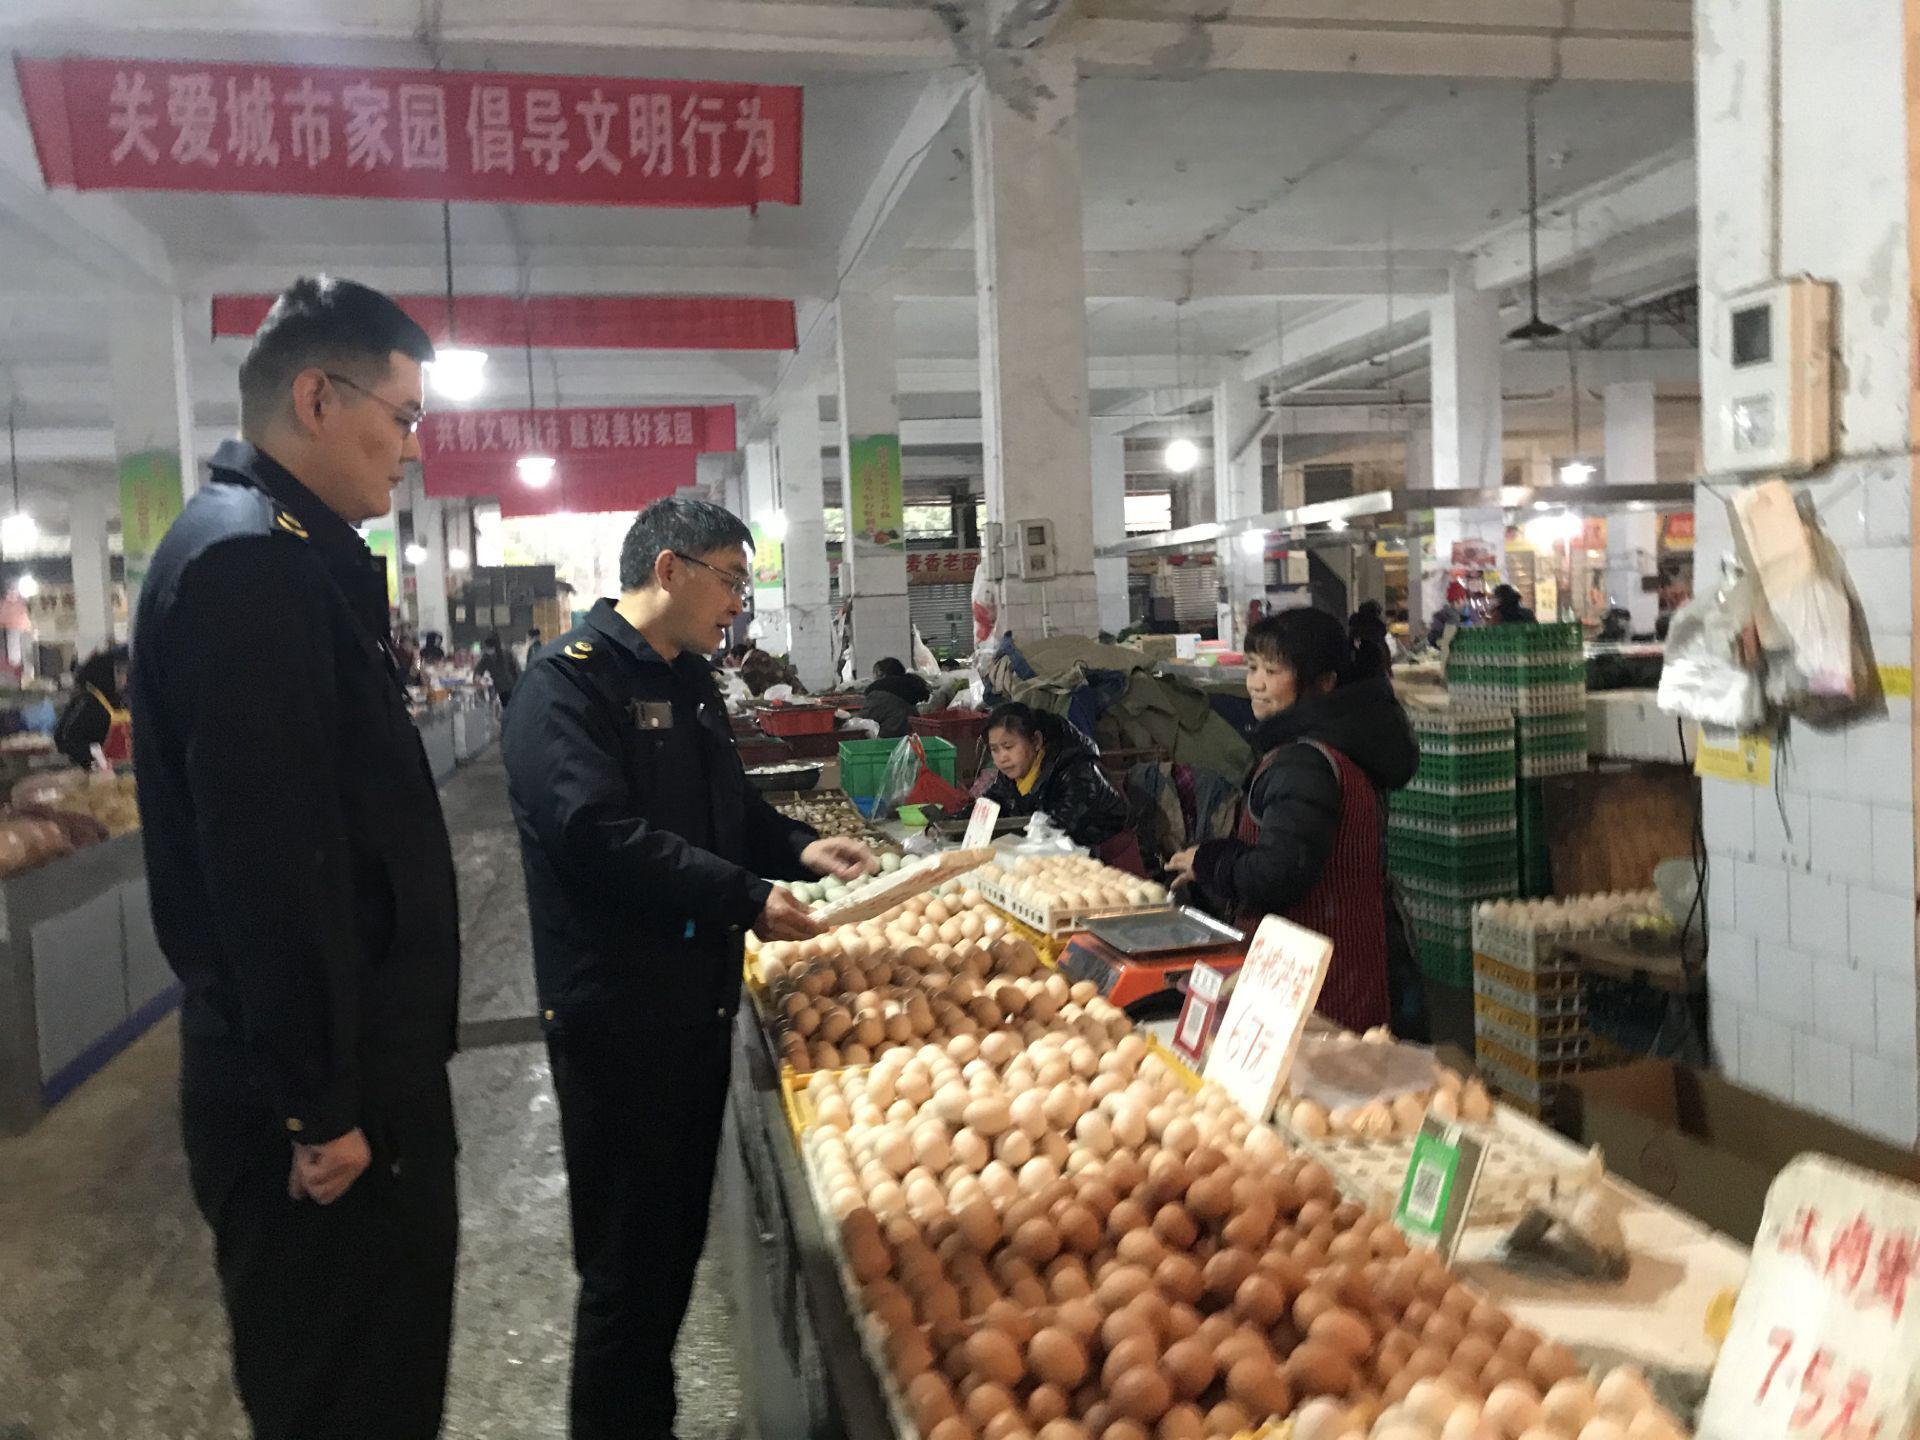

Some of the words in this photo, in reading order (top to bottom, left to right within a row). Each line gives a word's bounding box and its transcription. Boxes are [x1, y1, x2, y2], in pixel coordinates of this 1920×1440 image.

[108, 69, 448, 172] 关爱城市家园
[466, 84, 775, 178] 倡导文明行为
[570, 410, 694, 448] 建设美好家园
